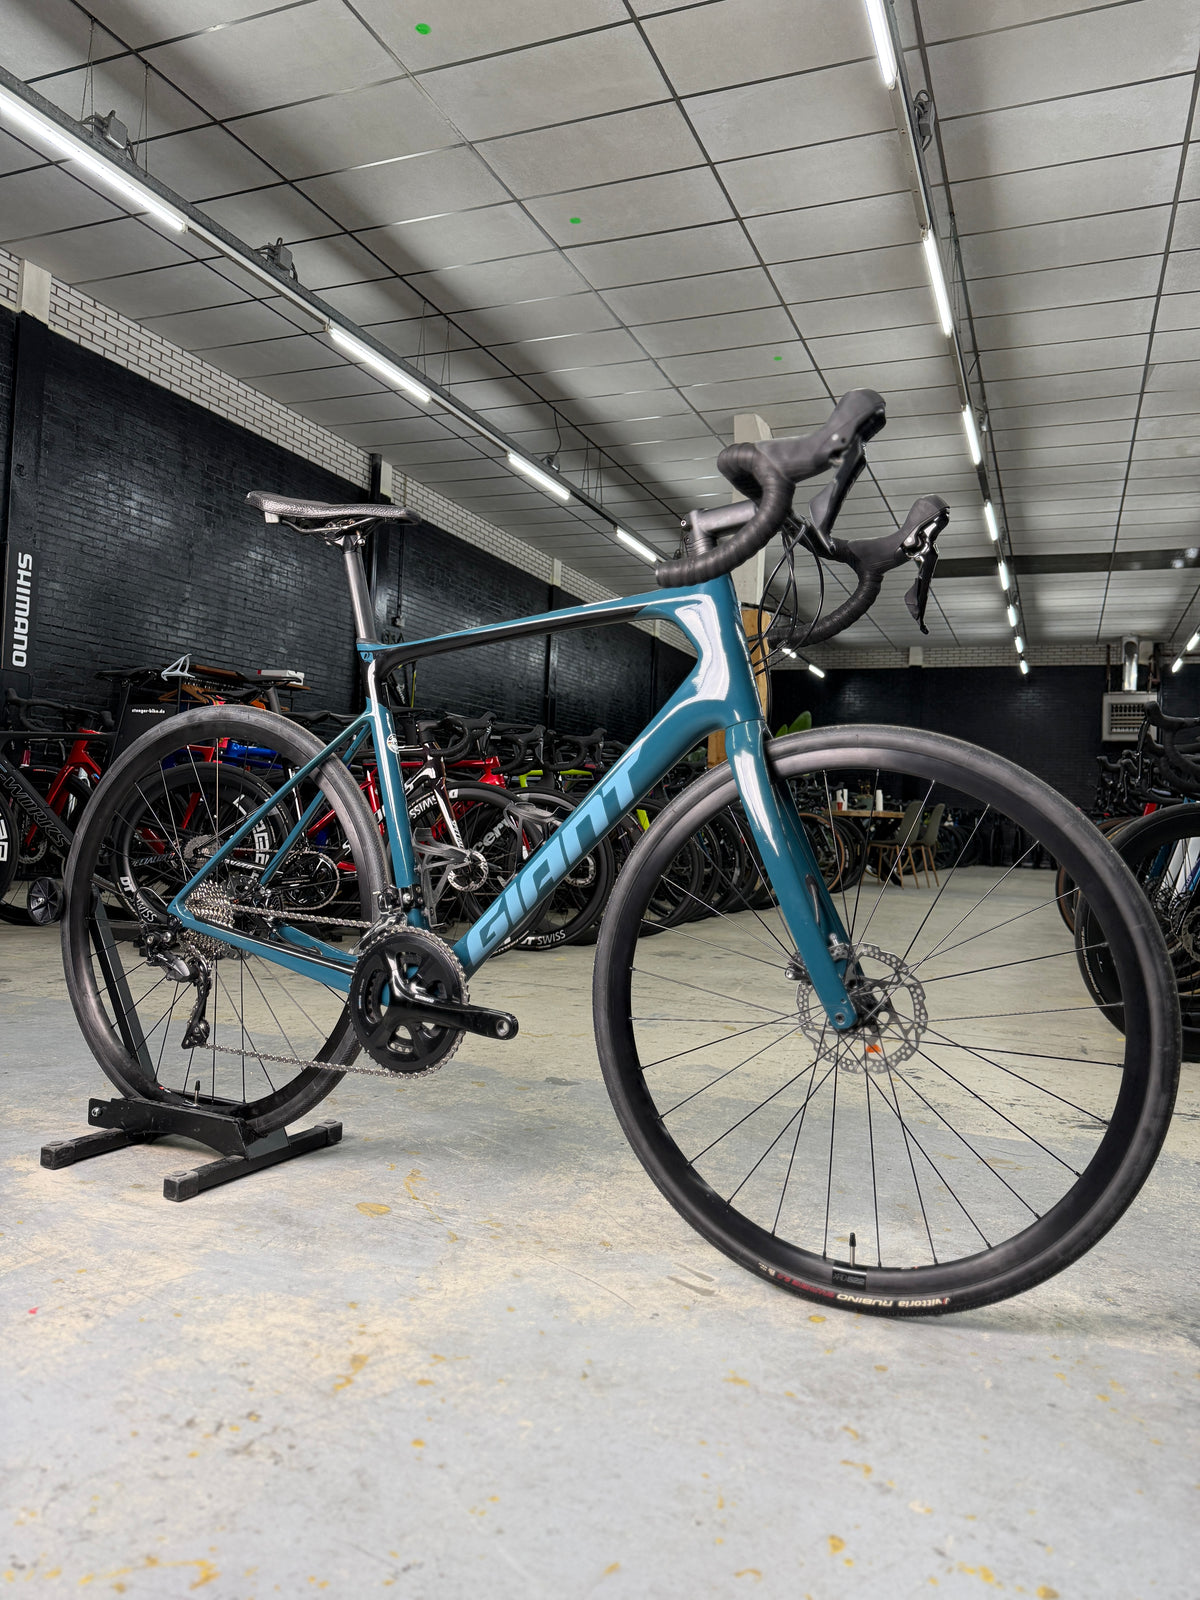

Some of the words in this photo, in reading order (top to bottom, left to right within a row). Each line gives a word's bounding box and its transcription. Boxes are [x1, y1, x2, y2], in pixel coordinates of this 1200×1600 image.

[12, 552, 32, 668] SHIMANO
[120, 876, 137, 893] DT
[136, 894, 157, 923] WISS
[537, 929, 566, 945] SWISS
[836, 1293, 894, 1307] RUBINO
